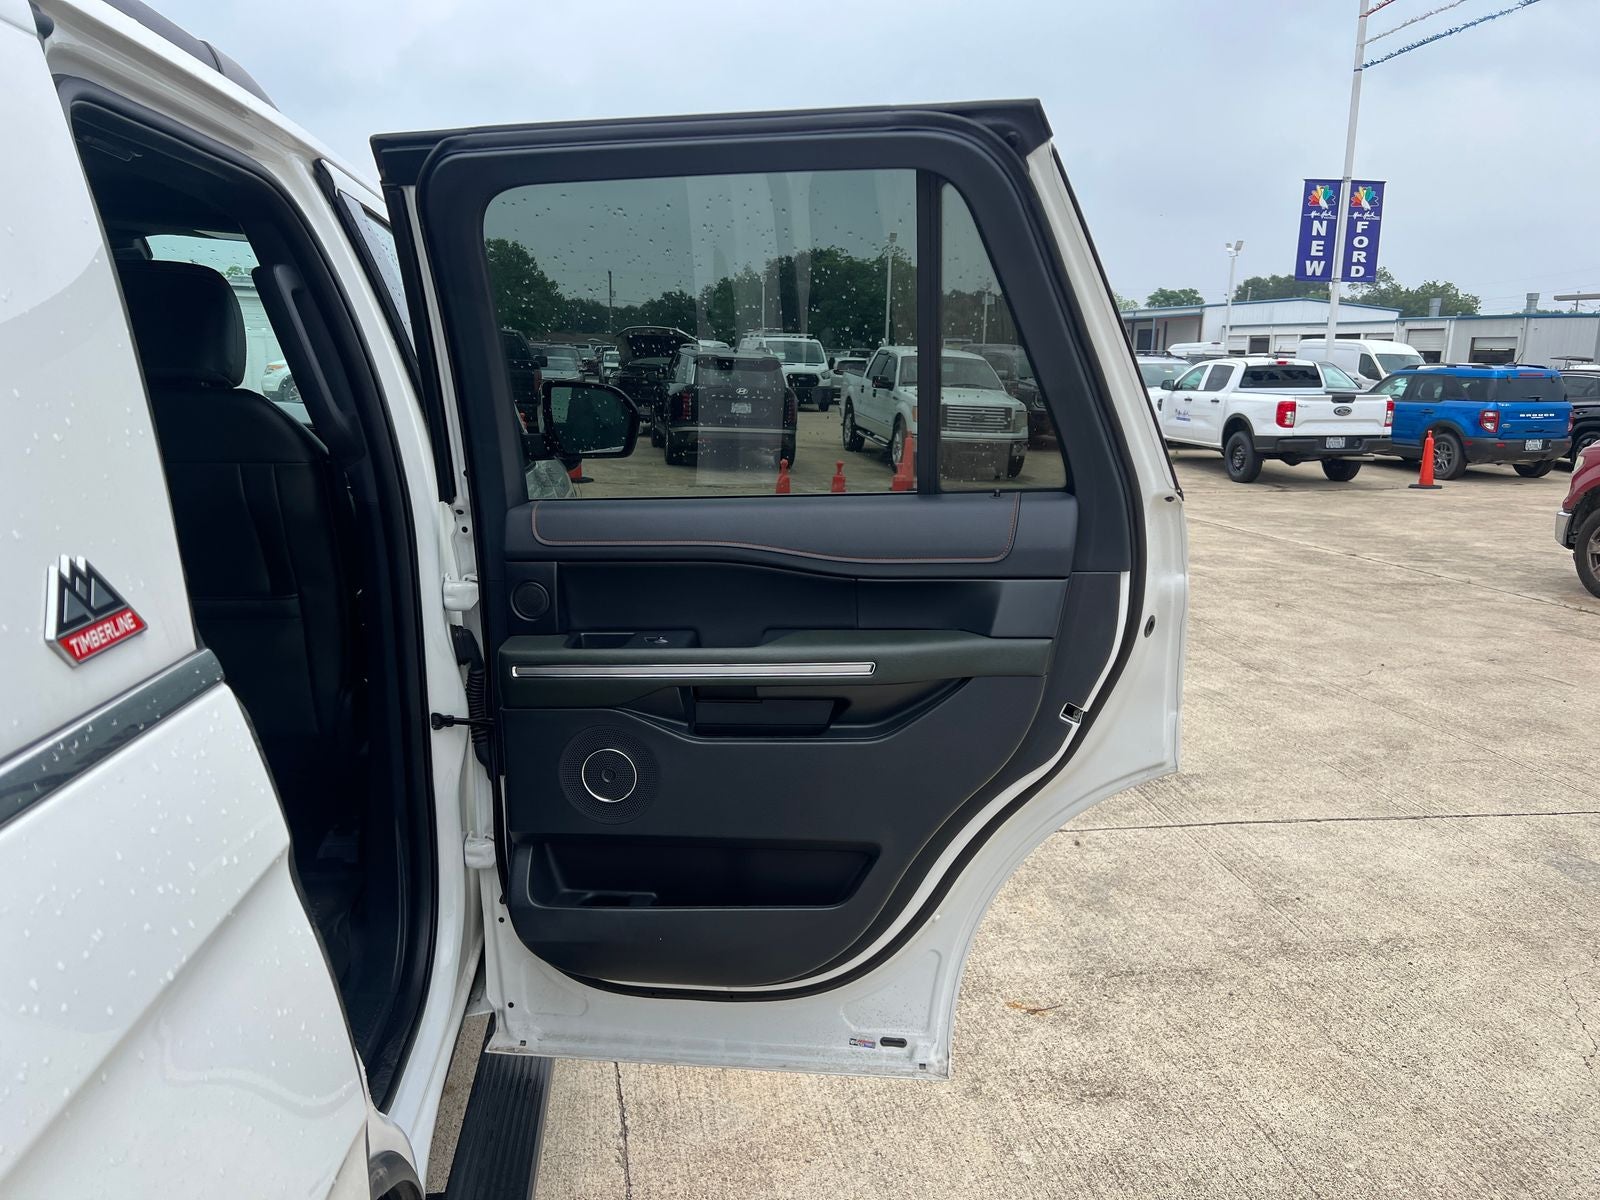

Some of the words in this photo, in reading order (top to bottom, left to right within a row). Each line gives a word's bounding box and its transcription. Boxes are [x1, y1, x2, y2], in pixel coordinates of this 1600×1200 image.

[1305, 220, 1328, 276] NEW
[1350, 221, 1369, 278] FORD
[68, 612, 137, 657] TIMBERLINE
